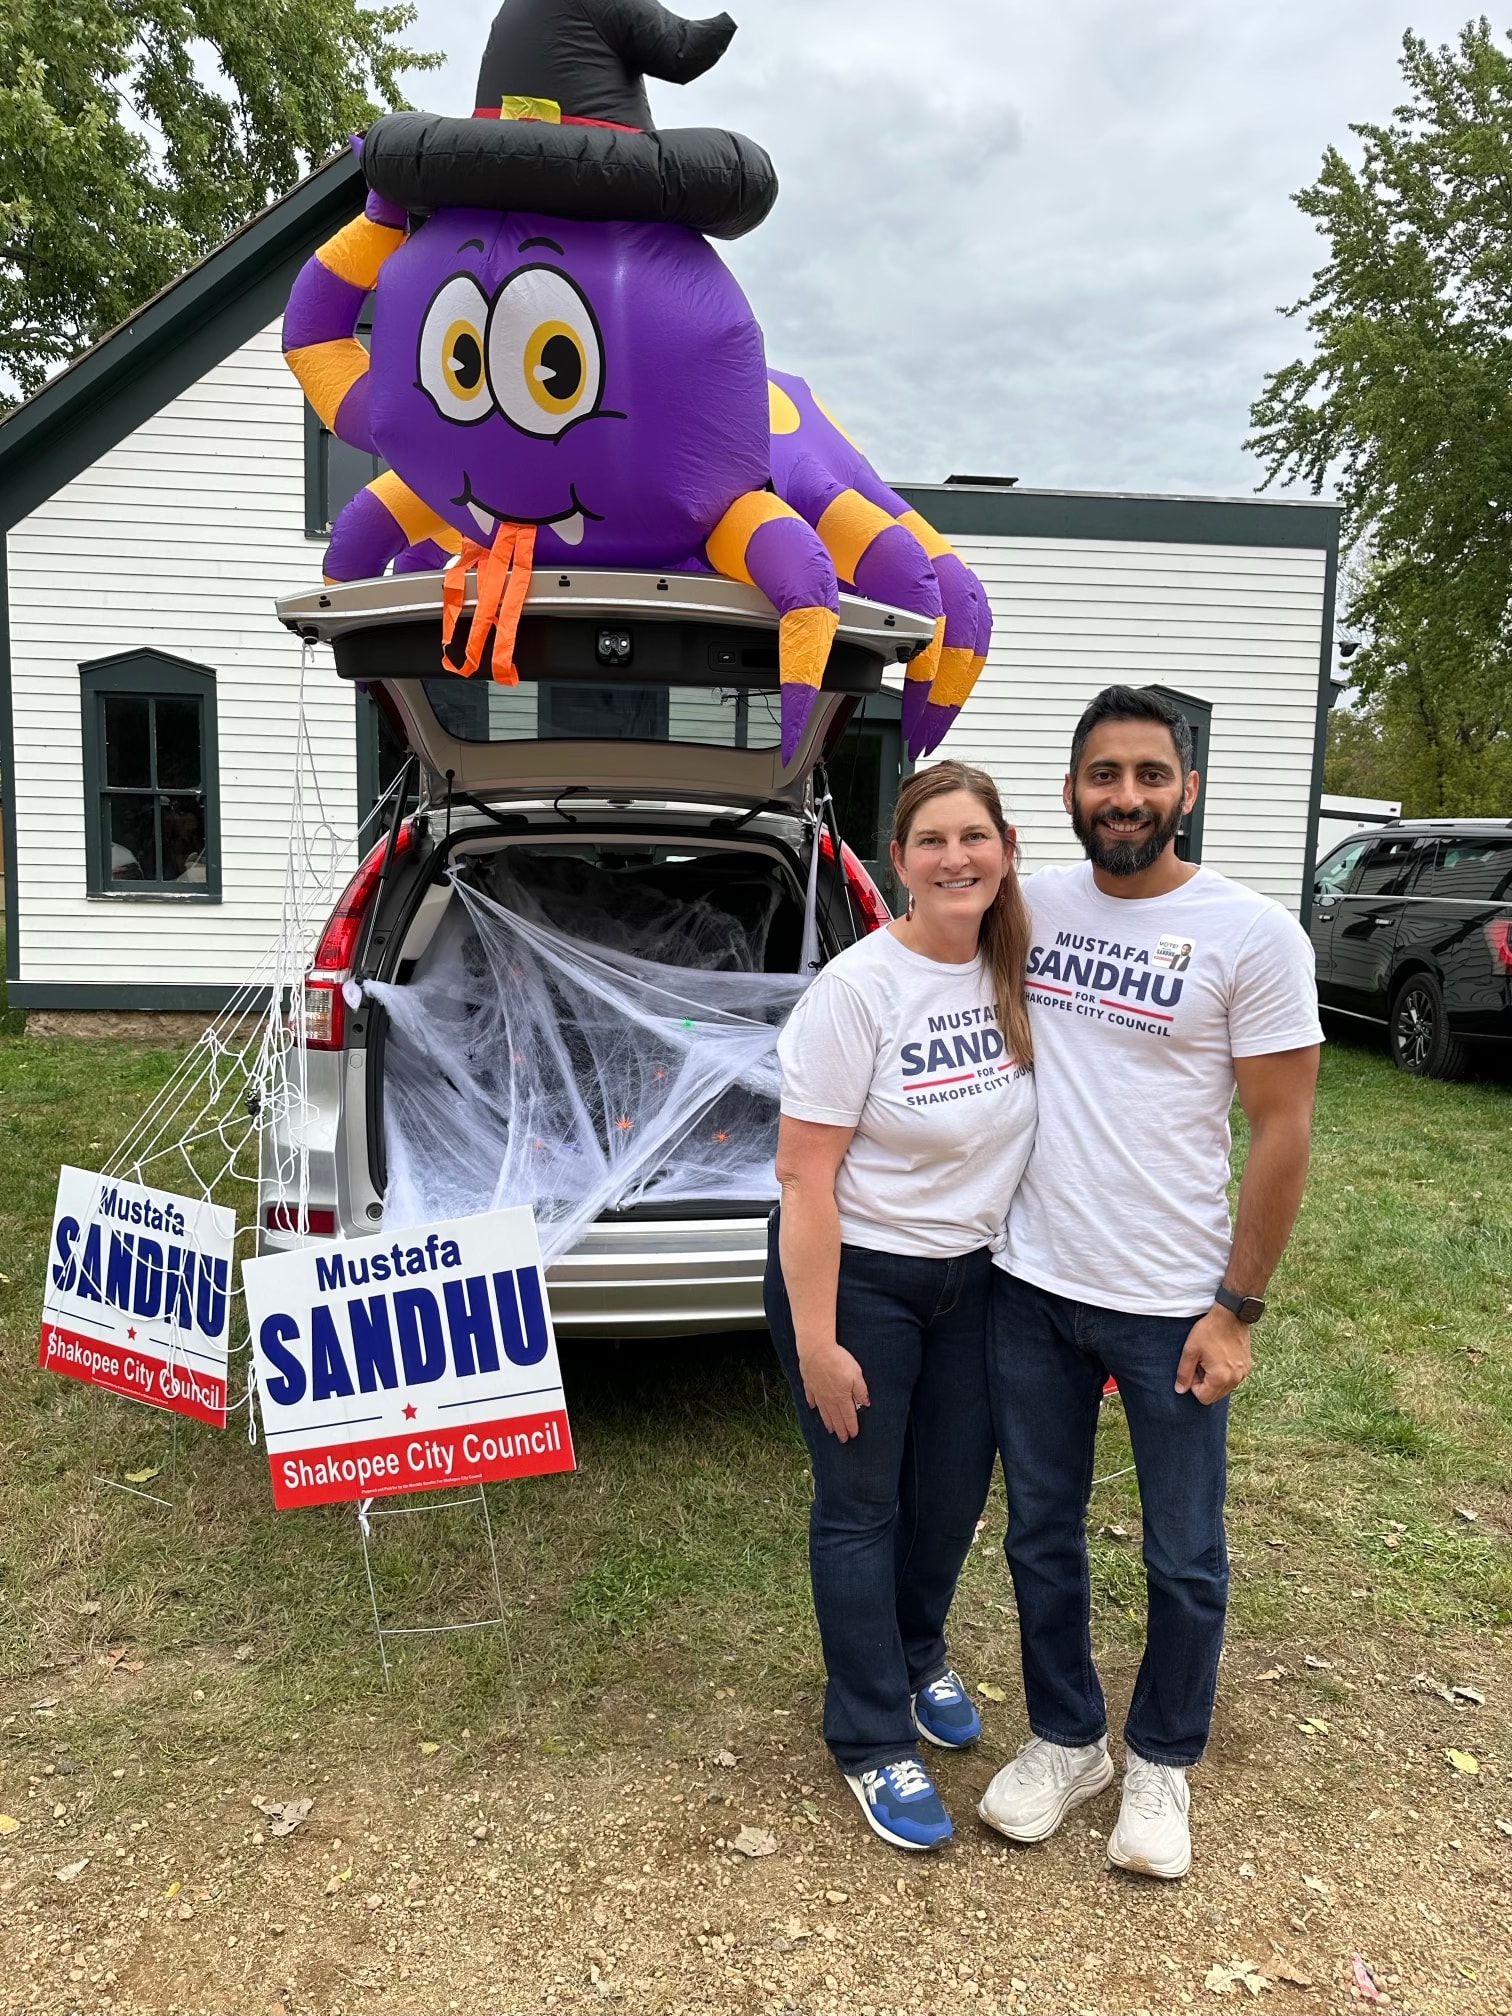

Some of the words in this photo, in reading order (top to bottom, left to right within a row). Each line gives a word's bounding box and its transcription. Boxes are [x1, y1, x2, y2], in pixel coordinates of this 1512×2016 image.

[1055, 931, 1149, 965] MUSTAFA
[1026, 946, 1184, 1007] SANDHU
[1075, 991, 1096, 1003] FOR
[928, 1003, 1000, 1033] MUSTAF
[1024, 991, 1072, 1011] HAKOPEE
[1076, 1005, 1105, 1020] CITY
[1108, 1013, 1171, 1037] COUNCIL
[900, 1028, 1004, 1077] SAND
[977, 1066, 995, 1078] FOR
[906, 1083, 982, 1106] SHAKOPEE
[984, 1074, 1011, 1091] CITY
[99, 1185, 185, 1237] Mustafa
[52, 1215, 229, 1338] SANDHU
[315, 1234, 462, 1292] Mustafa
[259, 1265, 550, 1406] SANDHU
[48, 1332, 120, 1376] Shakopee
[123, 1357, 155, 1392] City
[159, 1367, 220, 1409] Council
[282, 1454, 401, 1487] Shakopee
[406, 1439, 454, 1474] City
[462, 1421, 562, 1463] Council
